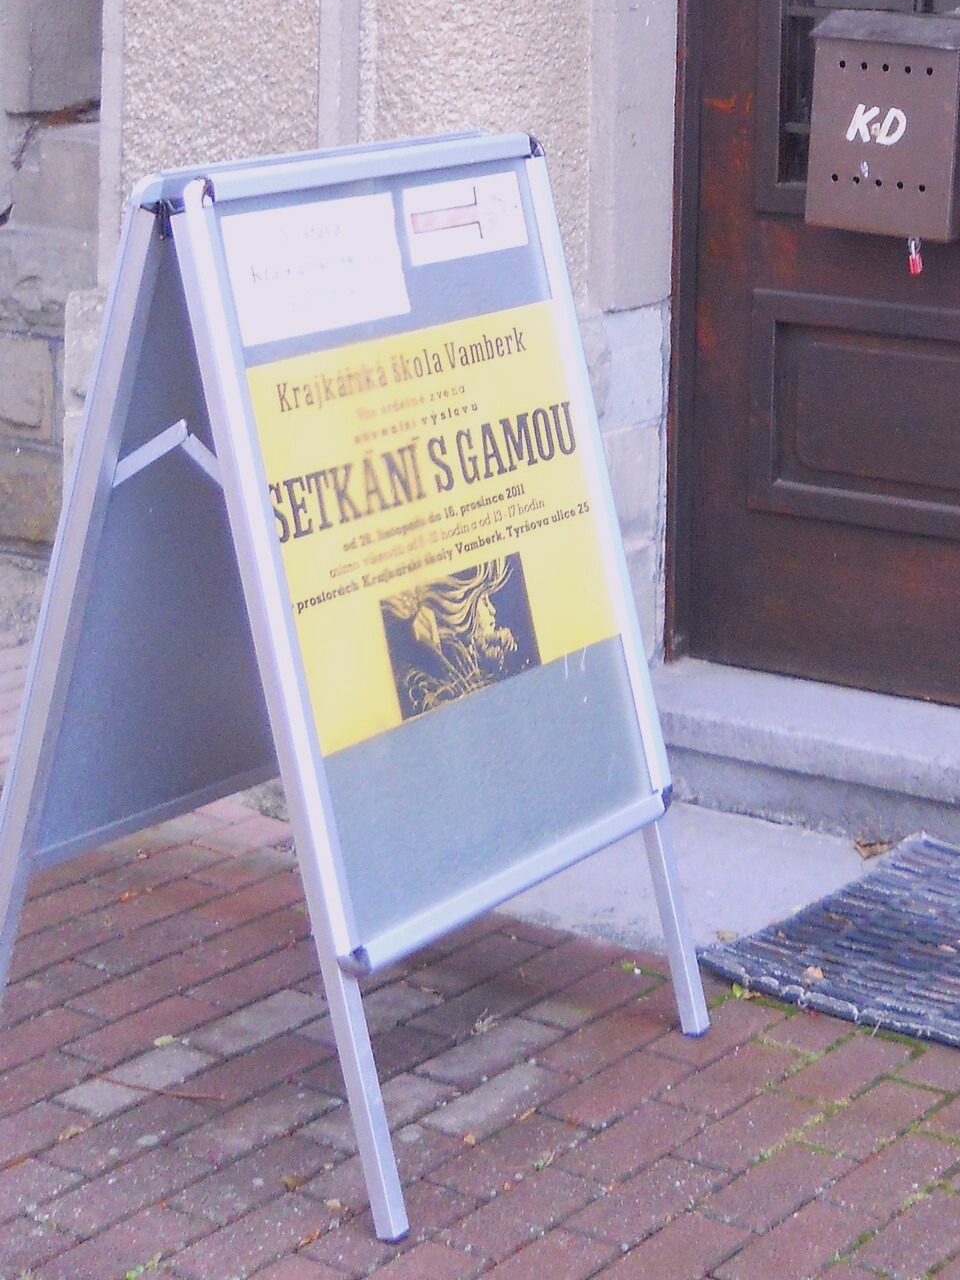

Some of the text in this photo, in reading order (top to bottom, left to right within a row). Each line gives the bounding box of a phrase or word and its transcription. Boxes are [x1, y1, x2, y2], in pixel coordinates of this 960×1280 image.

[392, 348, 444, 384] škola
[444, 327, 527, 369] Vamberk
[269, 401, 577, 543] SETKÁNÍ S GAMOU
[441, 522, 470, 540] hodin
[479, 512, 491, 527] od
[518, 498, 545, 515] hodin
[460, 493, 504, 517] prosince
[505, 483, 526, 500] 2011
[506, 517, 549, 538] Tyršova
[551, 507, 577, 523] ulice
[578, 501, 590, 515] 25
